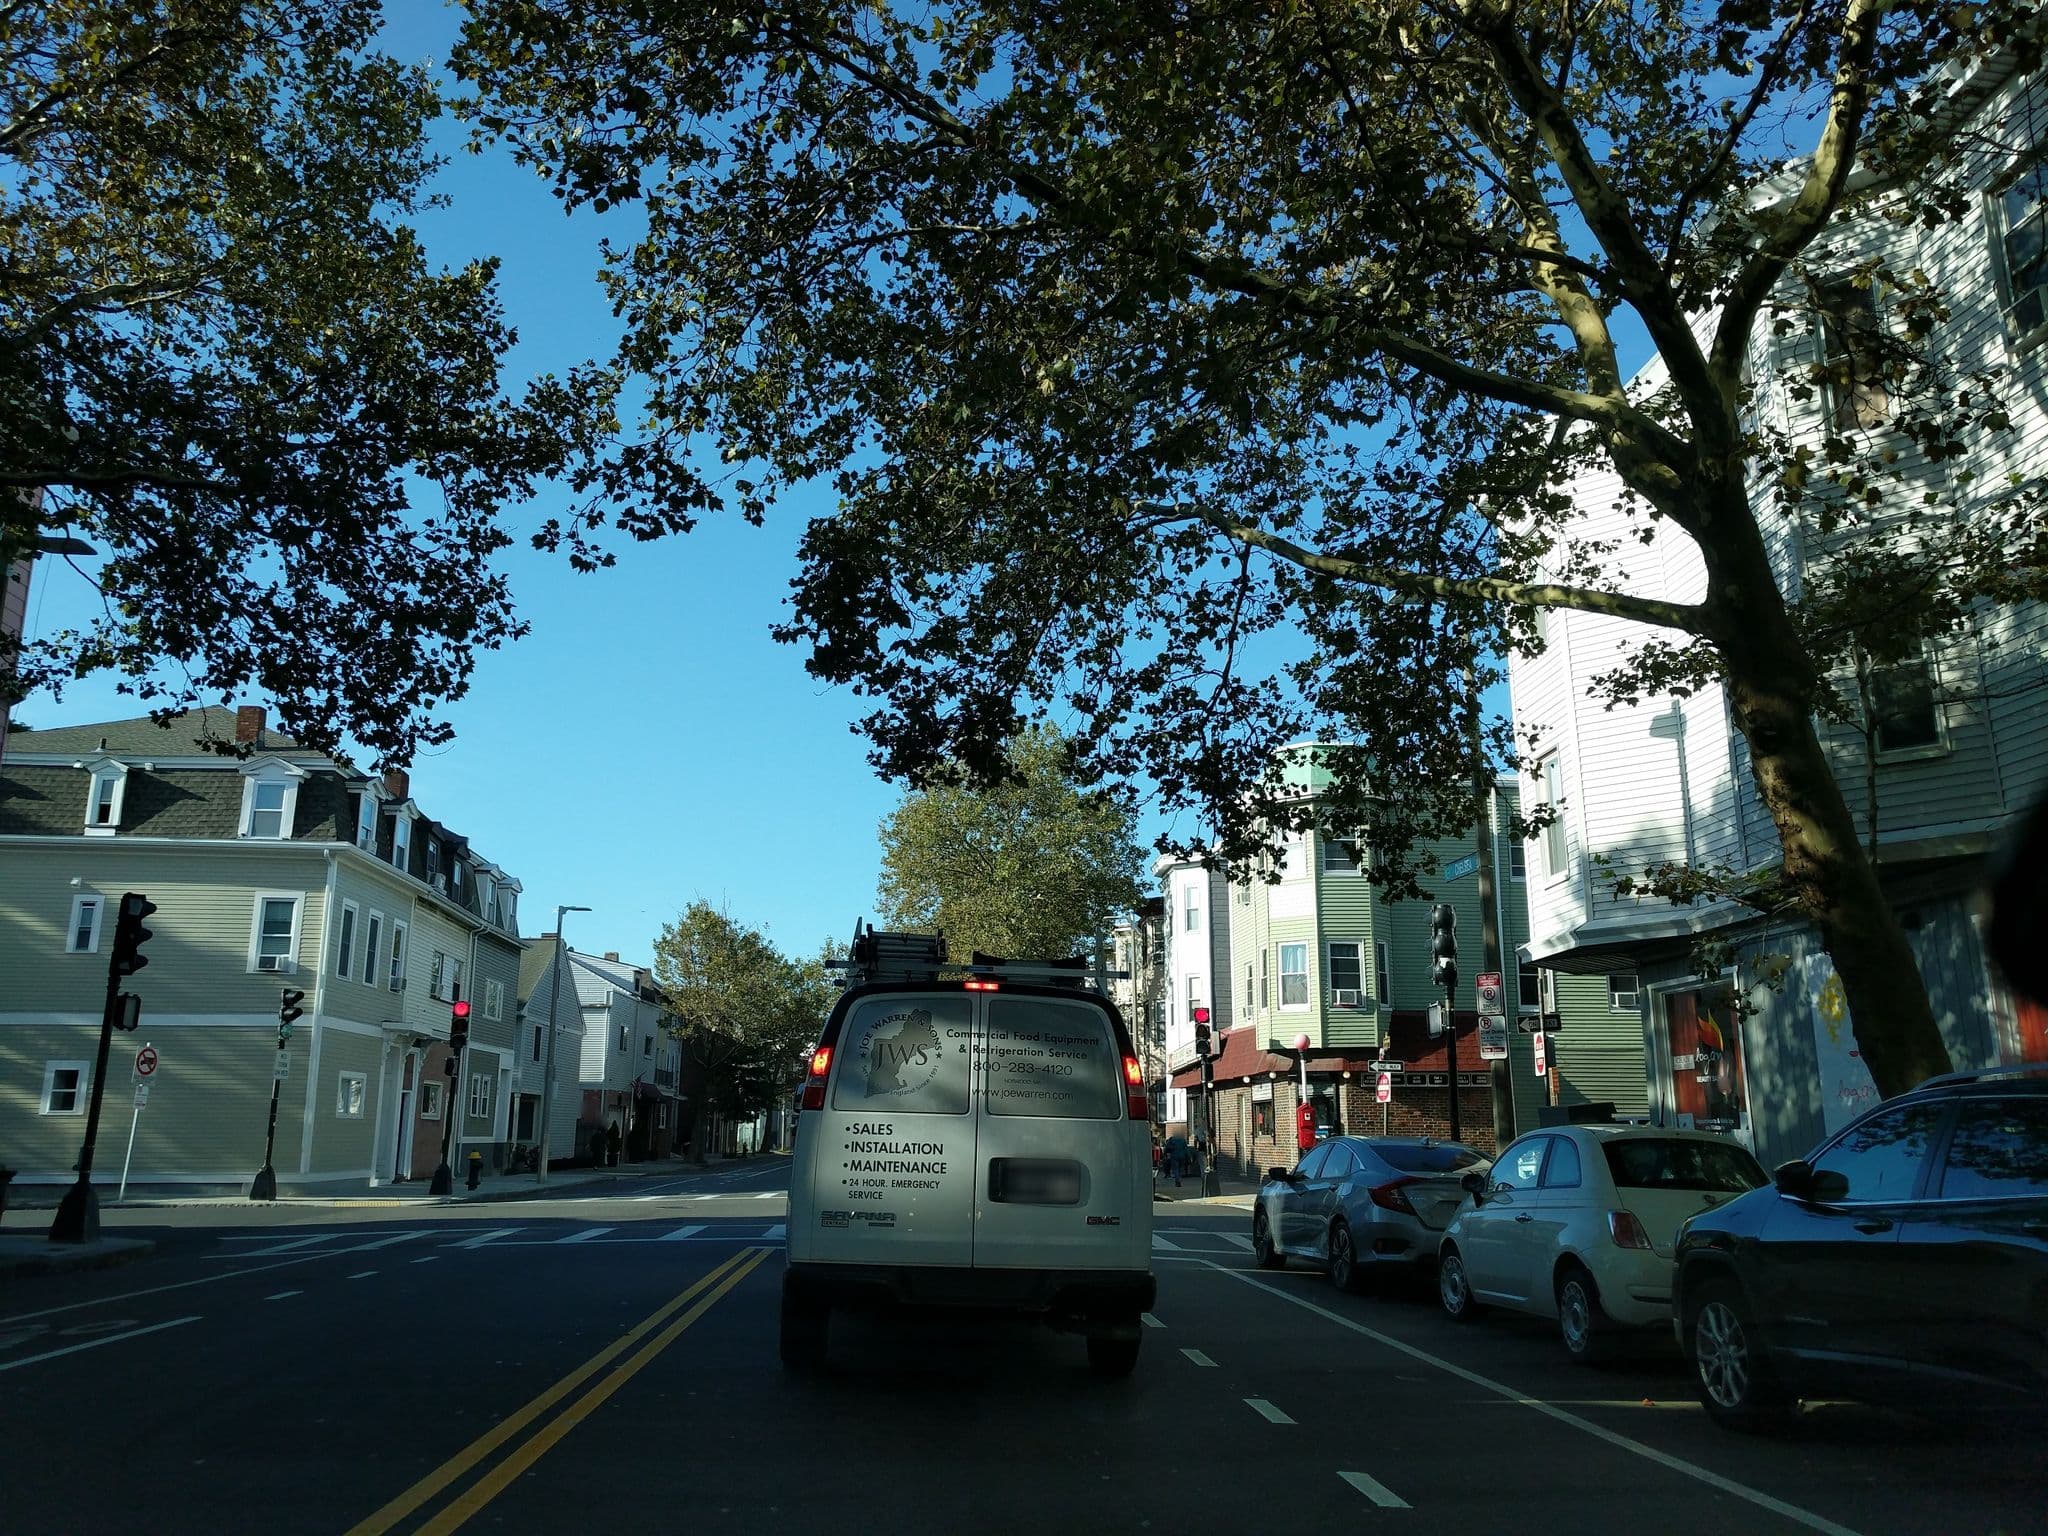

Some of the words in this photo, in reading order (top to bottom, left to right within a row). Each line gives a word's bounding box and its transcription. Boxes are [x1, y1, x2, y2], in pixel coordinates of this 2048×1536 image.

[860, 1031, 874, 1050] JOE
[871, 1013, 914, 1031] WARREN
[928, 1024, 943, 1051] SONS
[946, 1028, 1009, 1040] Commercial
[1013, 1031, 1040, 1042] Food
[1045, 1033, 1099, 1046] Equipment
[875, 1043, 928, 1071] JWS
[958, 1044, 967, 1054] &
[972, 1045, 1044, 1057] Refrigeration
[1048, 1048, 1088, 1060] Service
[972, 1061, 1073, 1075] 800-283-4120
[972, 1088, 1074, 1101] www.joewarren.com
[852, 1123, 893, 1135] SALES
[850, 1141, 944, 1155] INSTALLATION
[850, 1160, 947, 1174] MAINTENANCE
[849, 1178, 859, 1187] 24
[891, 1179, 940, 1189] EMERGENCY
[848, 1190, 883, 1200] SERVICE
